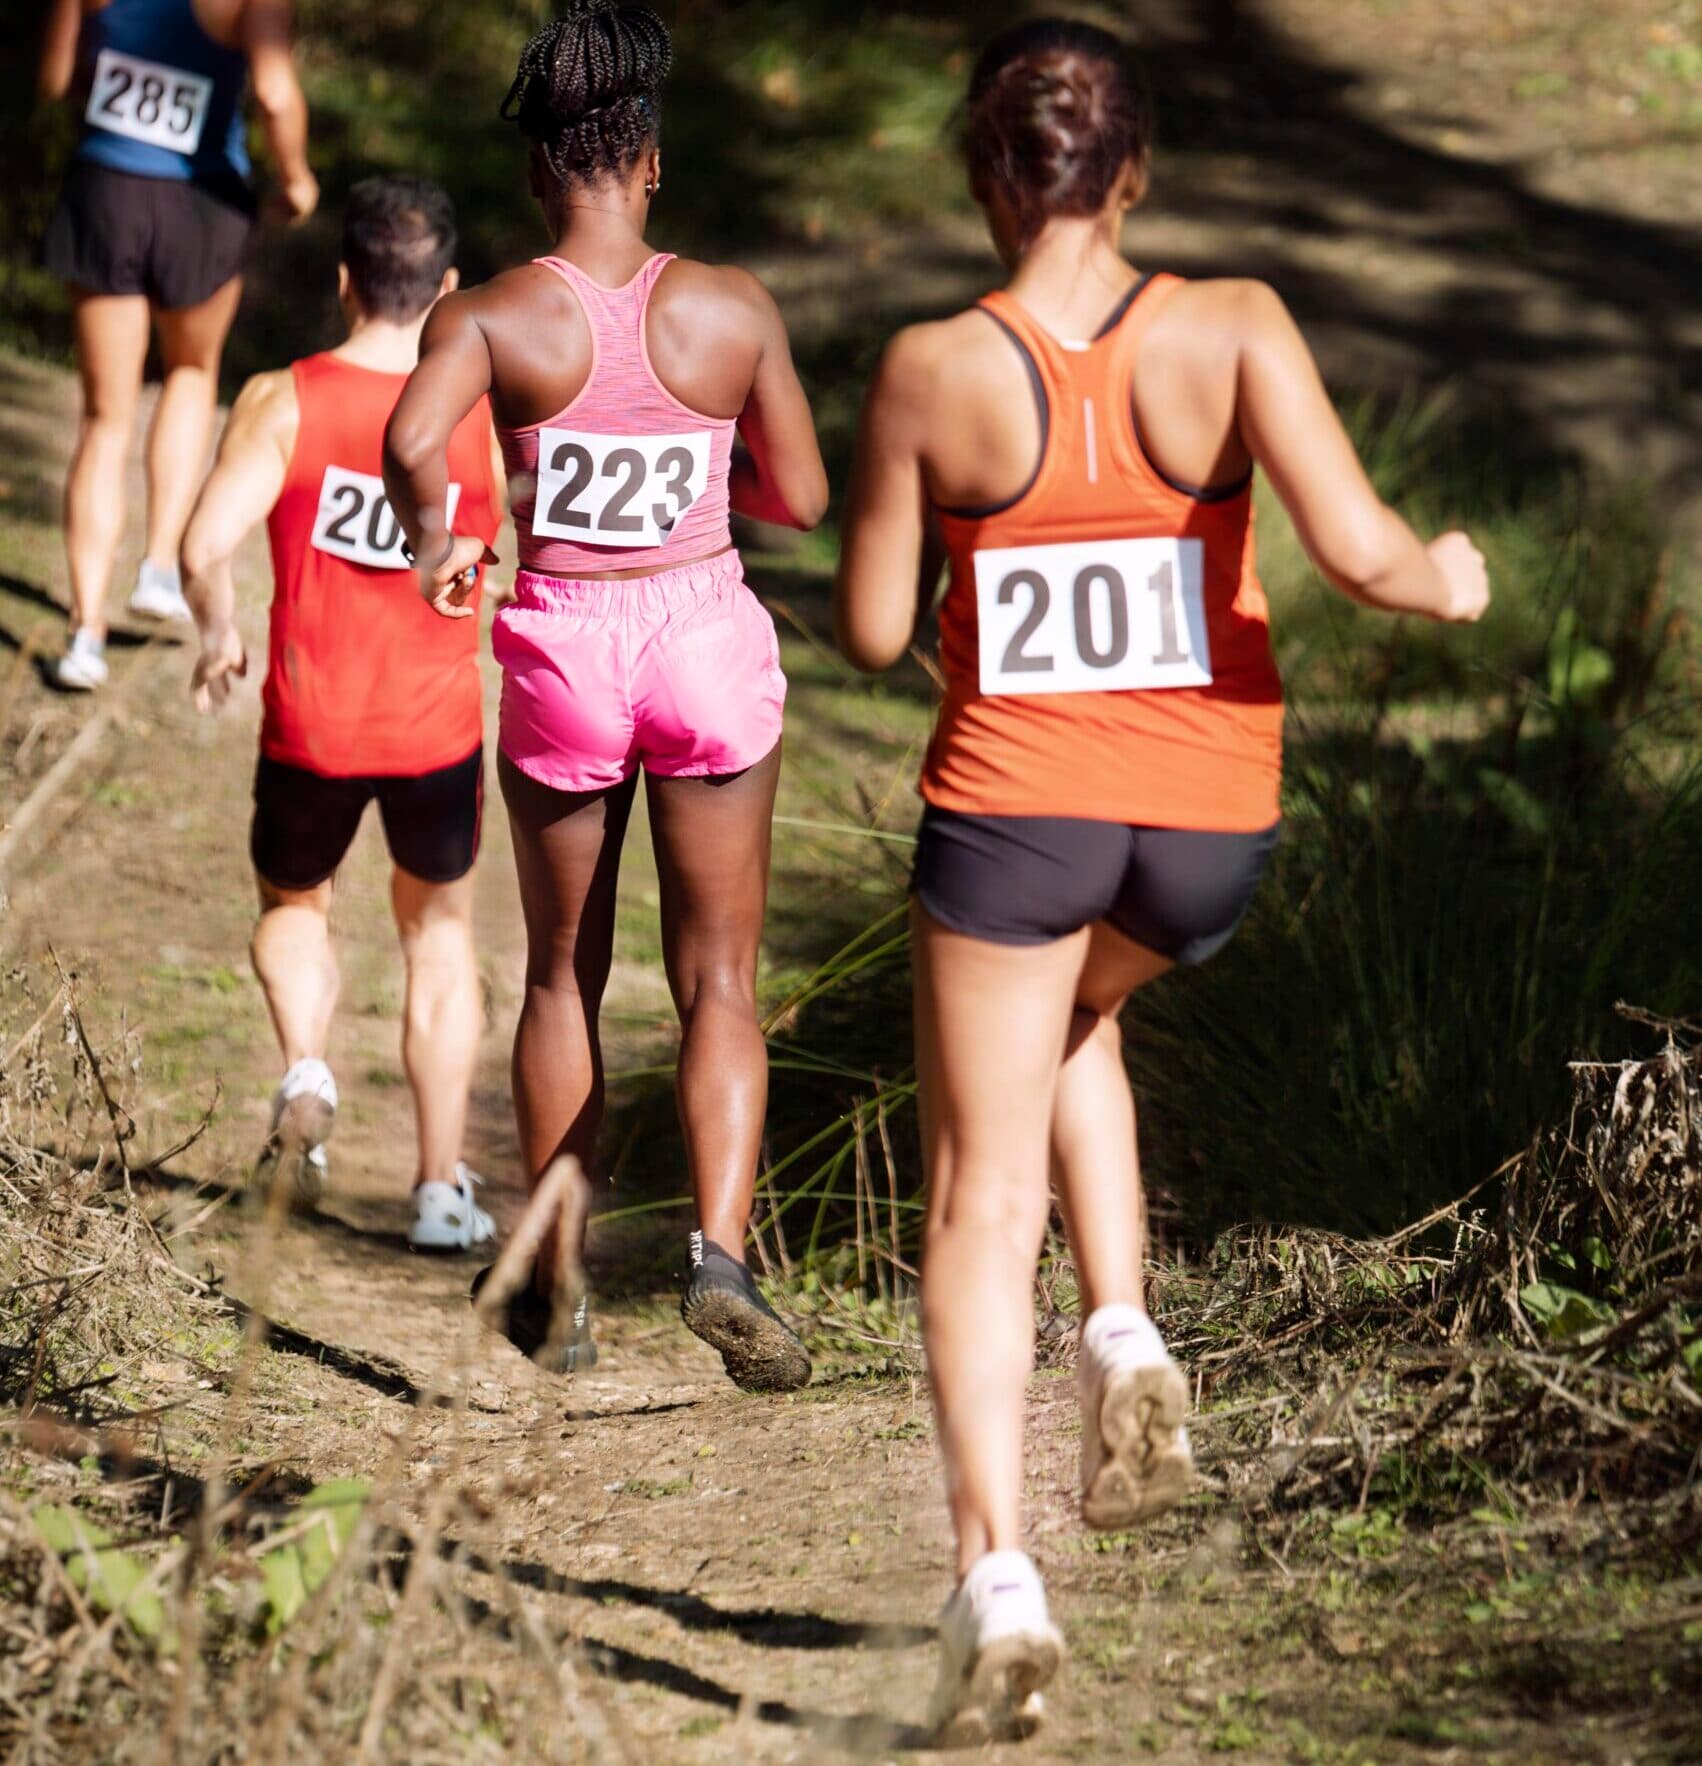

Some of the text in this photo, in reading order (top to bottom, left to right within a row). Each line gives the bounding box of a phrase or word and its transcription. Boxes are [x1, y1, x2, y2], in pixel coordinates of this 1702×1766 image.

[101, 66, 198, 134] 285
[324, 485, 402, 551] 20
[547, 443, 694, 532] 223
[997, 560, 1190, 674] 201
